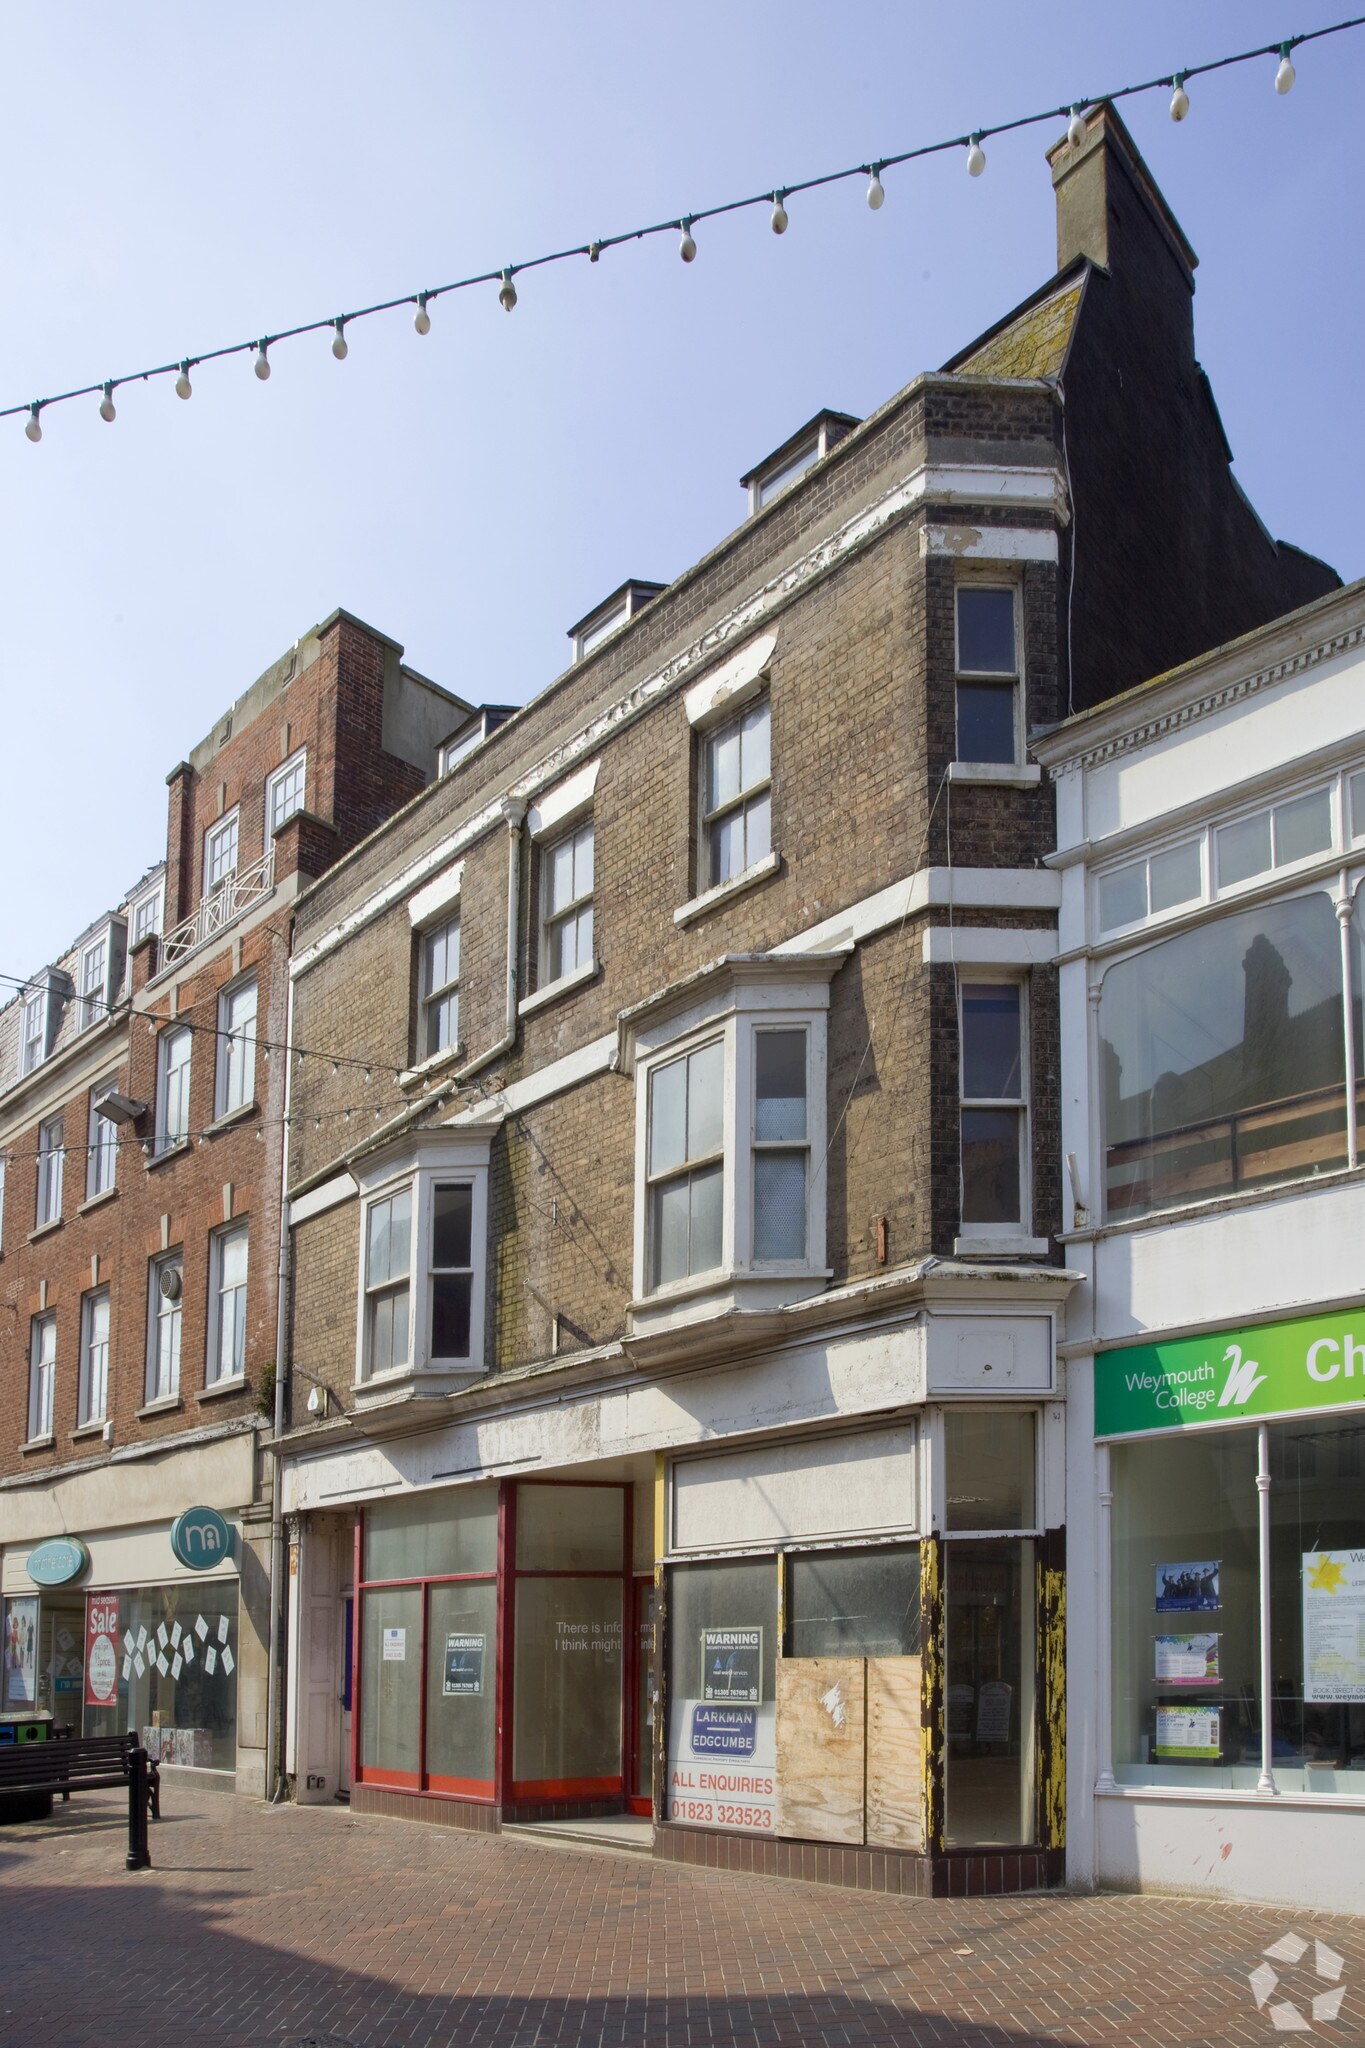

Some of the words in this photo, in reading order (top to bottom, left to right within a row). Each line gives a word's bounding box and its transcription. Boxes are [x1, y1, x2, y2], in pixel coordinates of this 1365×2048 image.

[1124, 1361, 1215, 1394] Weymouth
[1155, 1388, 1216, 1410] College
[90, 1605, 117, 1634] Sale
[556, 1621, 588, 1634] There
[591, 1621, 601, 1633] is
[448, 1638, 483, 1648] WARNING
[561, 1639, 588, 1651] think
[591, 1638, 621, 1653] might
[706, 1633, 759, 1645] WARNING
[696, 1711, 752, 1724] LARKMAN
[693, 1735, 753, 1749] EDGCUMBE
[672, 1771, 696, 1788] ALL
[700, 1773, 773, 1795] ENQUIRIES
[672, 1800, 713, 1822] 01823
[717, 1804, 771, 1828] 323523
